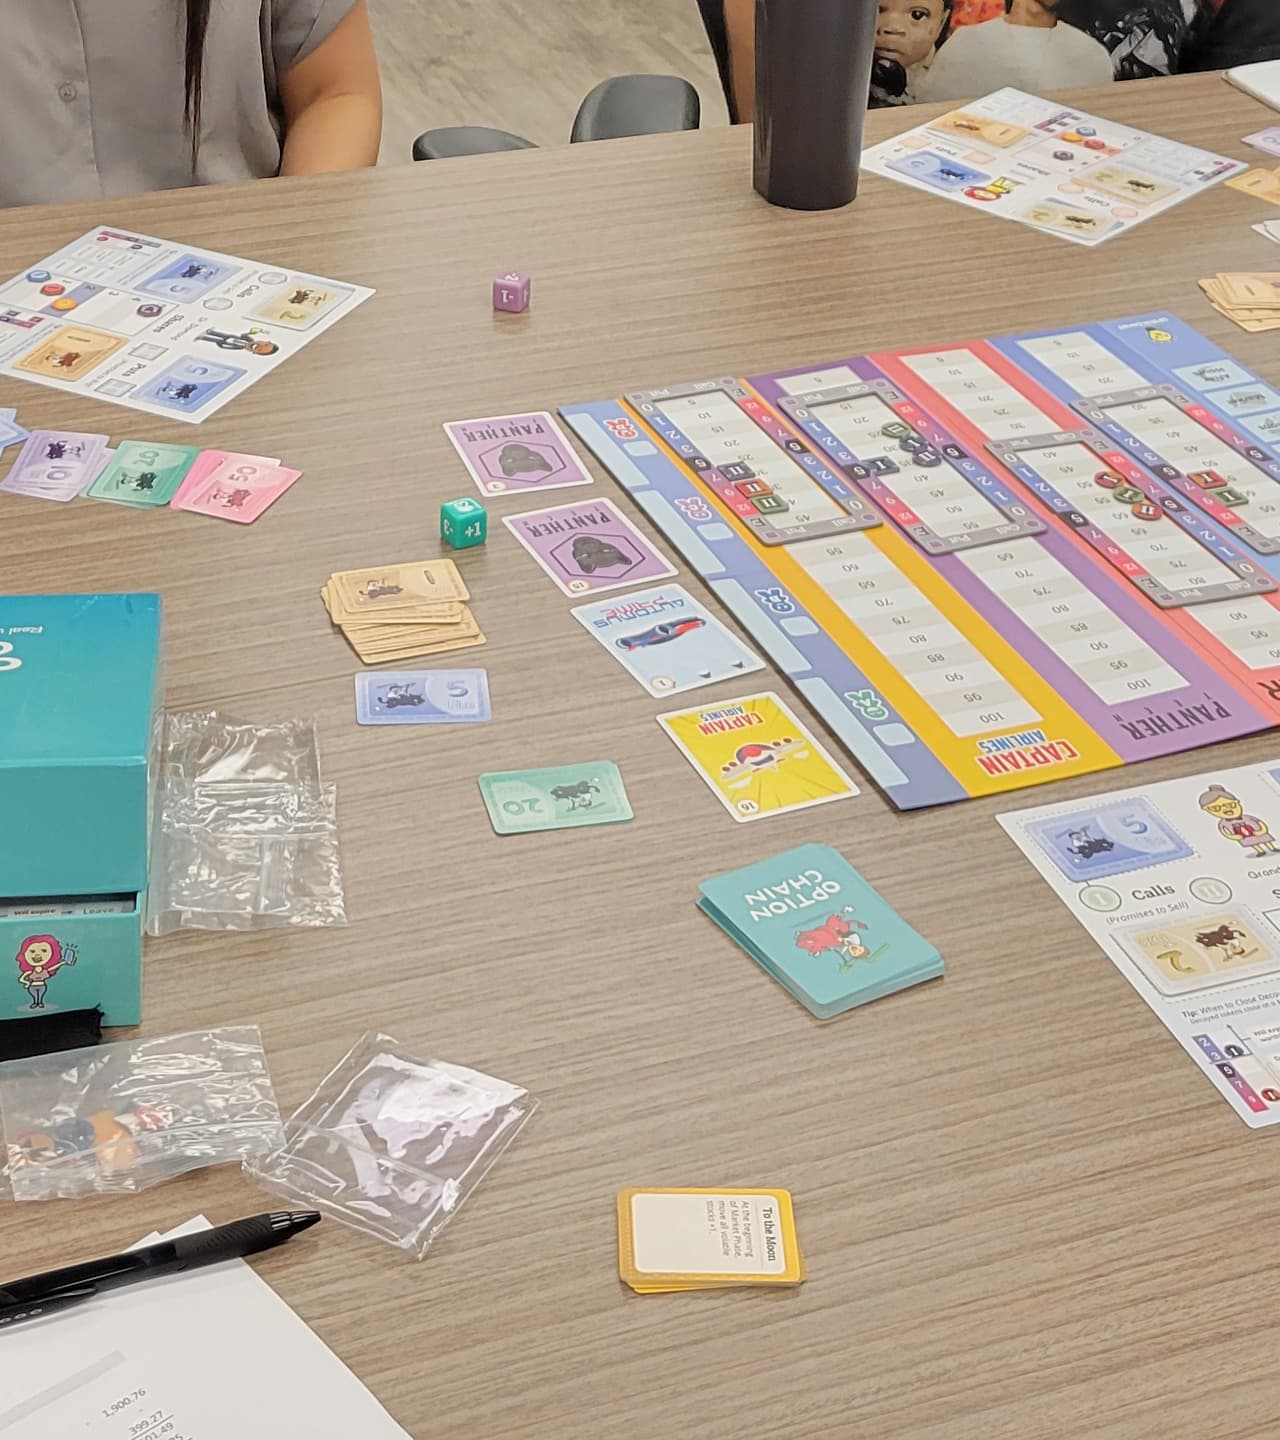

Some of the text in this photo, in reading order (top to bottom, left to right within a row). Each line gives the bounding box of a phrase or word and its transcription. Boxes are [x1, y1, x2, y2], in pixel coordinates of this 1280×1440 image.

[464, 424, 544, 442] PANTHER
[465, 521, 481, 537] +1
[526, 511, 610, 537] PANTHER
[826, 547, 843, 556] 55
[997, 552, 1014, 561] 65
[842, 563, 859, 573] 60
[1016, 569, 1033, 578] 70
[858, 580, 875, 590] 65
[1034, 587, 1051, 596] 75
[875, 598, 893, 607] 70
[1051, 605, 1069, 614] 80
[892, 615, 910, 625] 75
[1229, 612, 1247, 622] 90
[8, 626, 43, 634] Real
[1071, 622, 1088, 632] 85
[909, 634, 927, 644] 80
[1250, 630, 1268, 640] 95
[1089, 641, 1108, 651] 90
[928, 652, 944, 663] 85
[1109, 660, 1127, 670] 95
[945, 672, 963, 682] 90
[1127, 679, 1151, 690] 100
[964, 692, 982, 703] 95
[699, 706, 744, 721] AIRLINES
[980, 711, 1004, 723] 100
[698, 712, 763, 735] CAPTAIN
[1120, 701, 1231, 740] PANTHER
[979, 730, 1045, 752] AIRLINES
[977, 740, 1077, 775] CAPTAIN
[741, 802, 755, 811] 16
[744, 870, 824, 906] CHAIN
[1132, 883, 1176, 902] Calls
[750, 880, 841, 921] OPTION
[1106, 908, 1154, 926] (Promises
[762, 1208, 776, 1261] To the Moon
[102, 1388, 146, 1417] 1,900.76
[128, 1410, 164, 1435] 399.27
